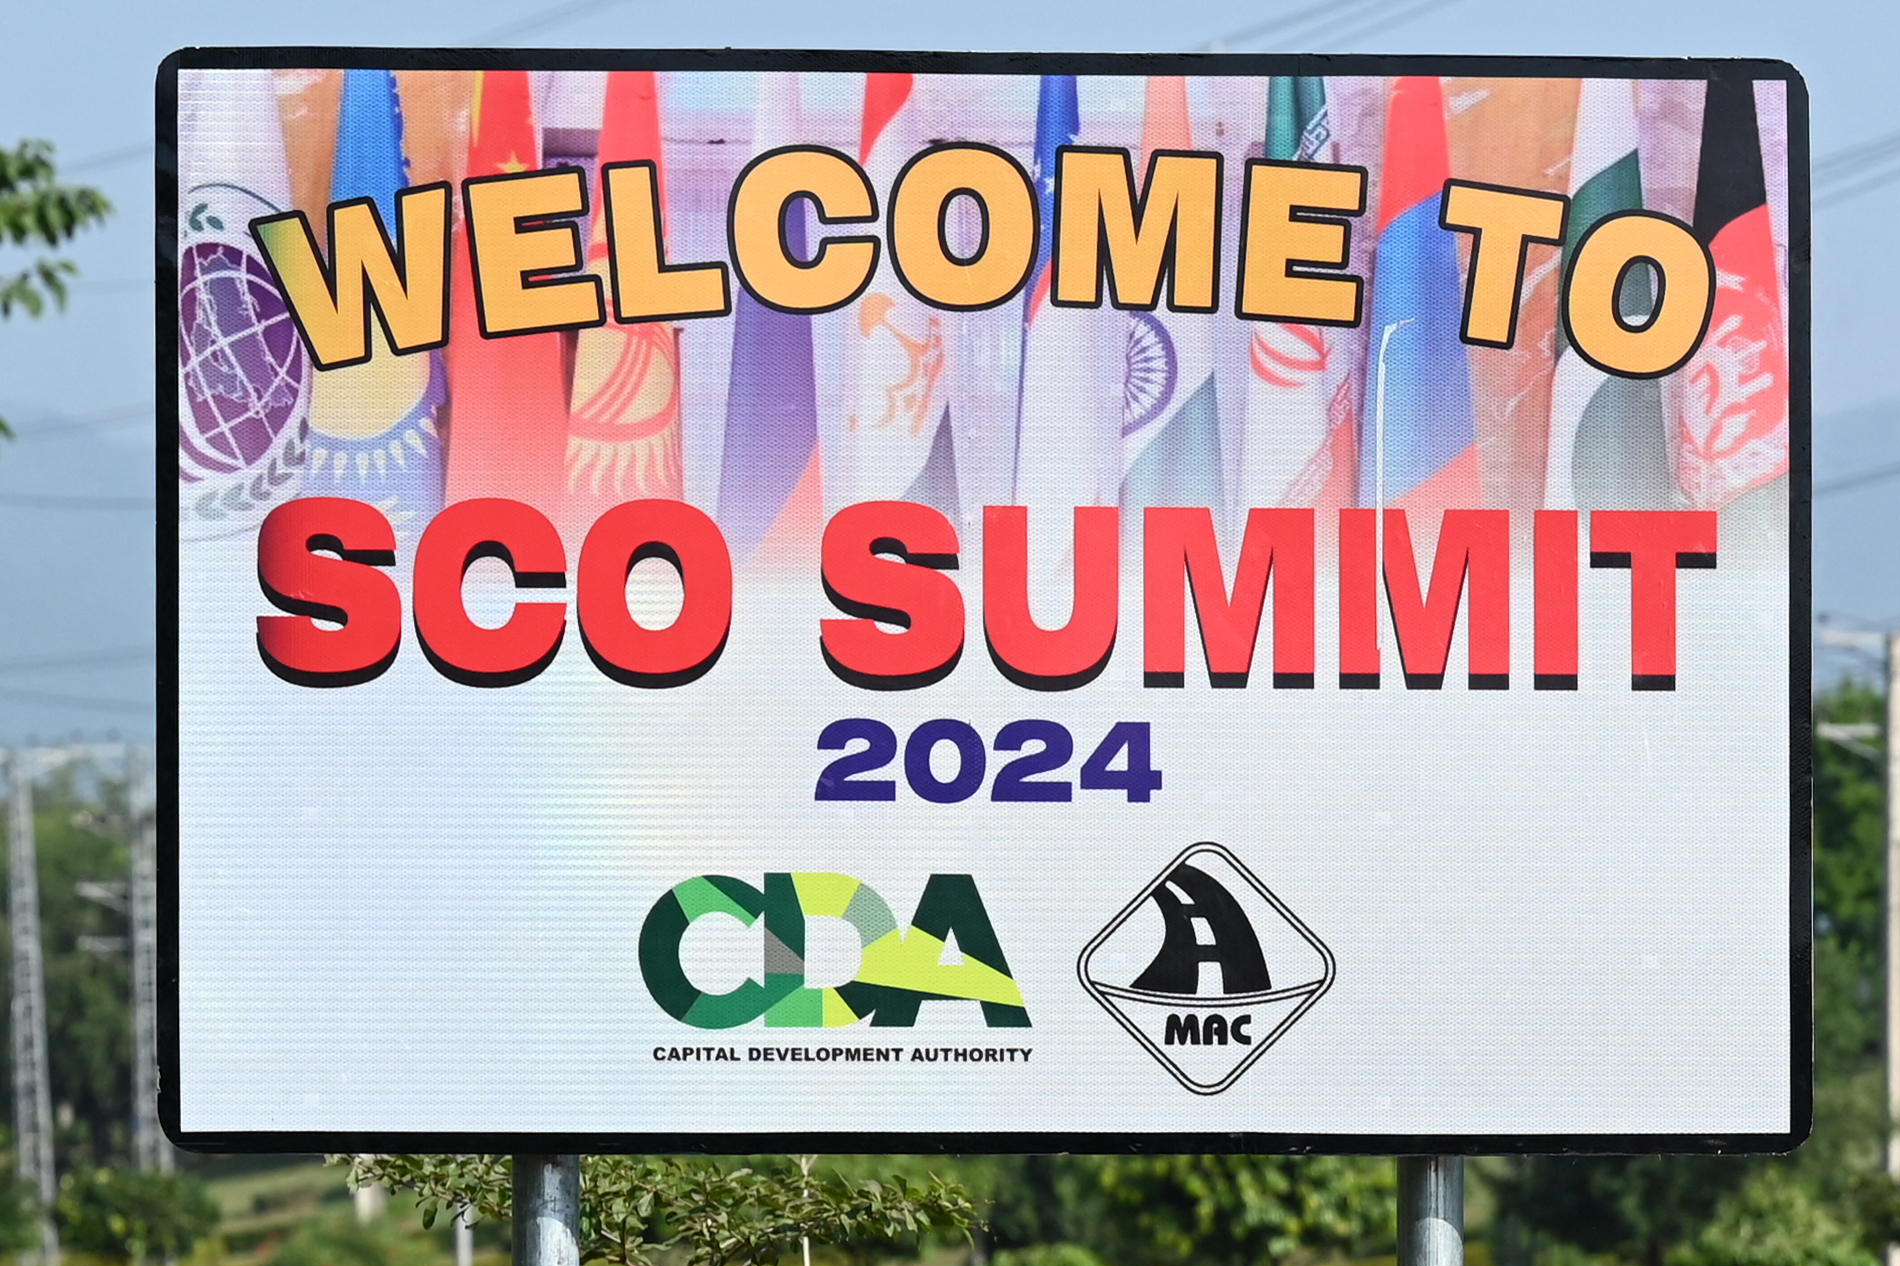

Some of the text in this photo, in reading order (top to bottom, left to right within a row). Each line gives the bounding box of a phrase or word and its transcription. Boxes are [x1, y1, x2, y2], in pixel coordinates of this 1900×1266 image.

[249, 141, 1717, 380] WELCOME TO
[256, 496, 1718, 692] SCO SUMMIT
[814, 717, 1163, 804] 2024
[638, 871, 1033, 1030] CDA
[652, 1046, 1034, 1063] CAPITAL DEVELOPMENT AUTHORITY
[1163, 1012, 1253, 1047] MAC
